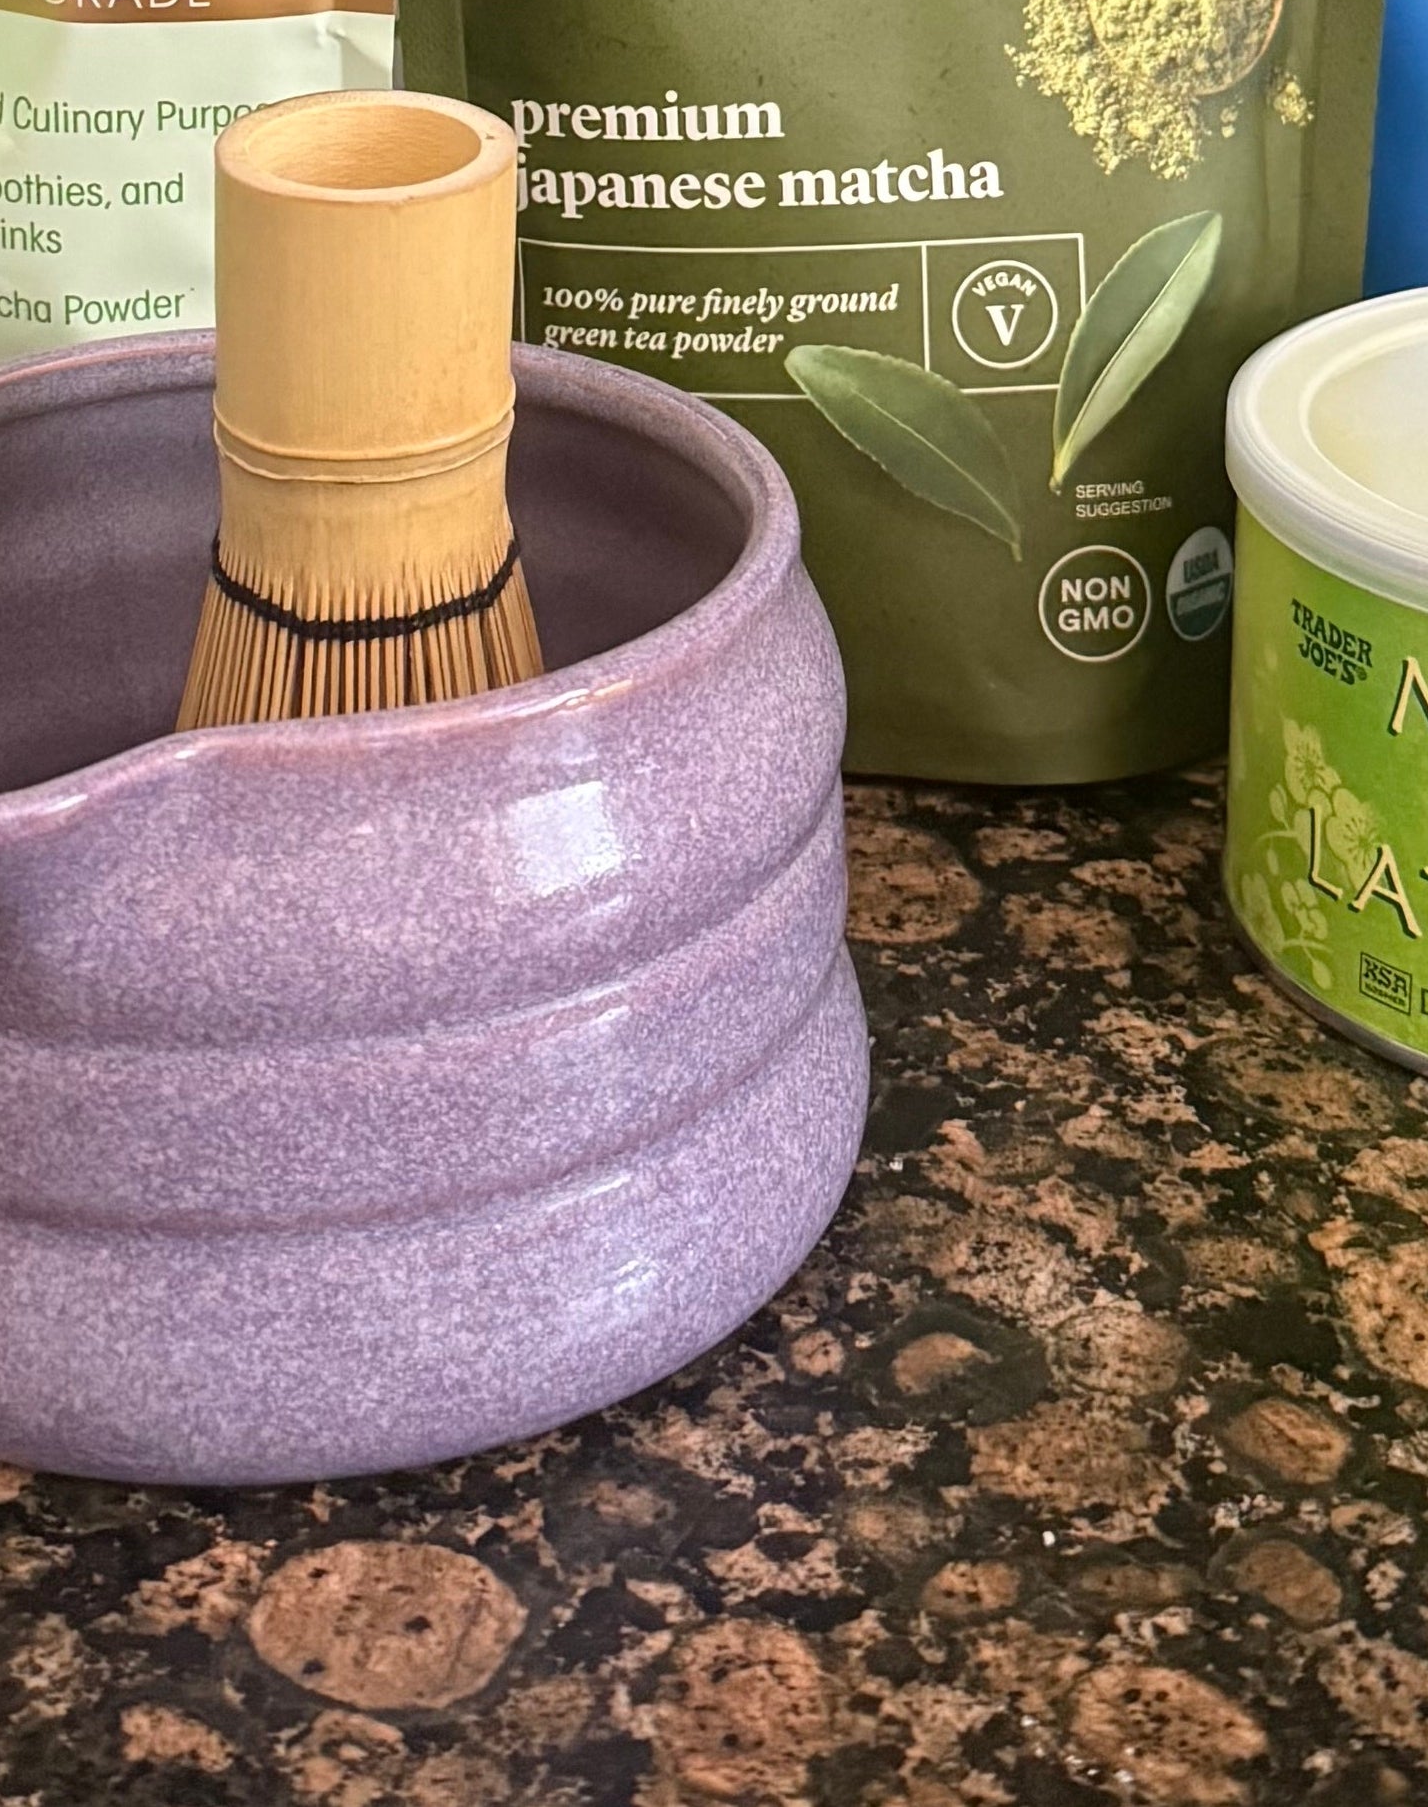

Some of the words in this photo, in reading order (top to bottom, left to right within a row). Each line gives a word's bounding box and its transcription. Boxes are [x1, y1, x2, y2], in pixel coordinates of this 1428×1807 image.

[13, 95, 145, 140] Culinary
[157, 100, 269, 136] Purpo
[511, 89, 784, 148] premium
[122, 173, 184, 205] and
[517, 152, 766, 219] japanese
[778, 148, 1004, 208] matcha
[972, 271, 1037, 297] VEGAN
[64, 290, 186, 325] Powder
[542, 286, 623, 312] 100%
[628, 290, 696, 319] pure
[696, 287, 784, 322] finely
[787, 283, 899, 322] ground
[544, 323, 617, 349] green
[624, 326, 666, 350] tea
[671, 326, 783, 358] powder
[985, 304, 1025, 346] V
[1076, 480, 1144, 498] SERVING
[1076, 497, 1172, 517] SUGGESTION
[1061, 575, 1130, 603] NON
[1058, 605, 1134, 632] GMO
[1292, 598, 1372, 667] TRADER
[1363, 958, 1409, 997] KSA
